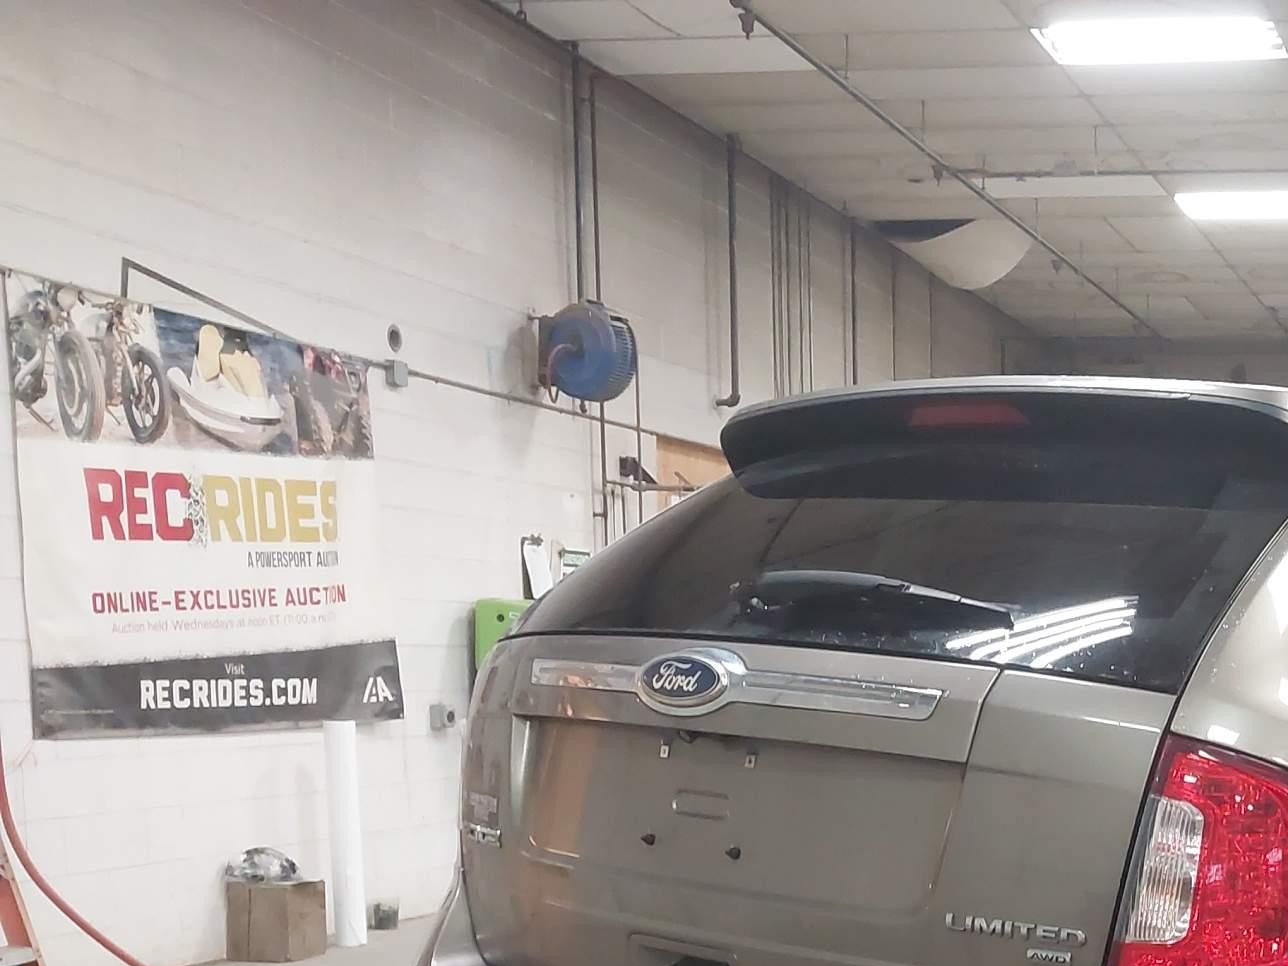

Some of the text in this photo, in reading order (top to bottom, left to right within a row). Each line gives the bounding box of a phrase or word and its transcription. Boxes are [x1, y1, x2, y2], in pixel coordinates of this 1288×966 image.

[84, 468, 338, 544] REC RIDES
[247, 551, 254, 568] A
[255, 551, 312, 568] POWERSPORT
[92, 584, 347, 614] ONLINE-EXCLUSIVE AUCTION
[224, 663, 245, 675] Visit
[652, 660, 701, 692] Ford
[140, 678, 318, 709] RECRIDES.COM
[945, 912, 1087, 946] LIMITED
[1028, 949, 1070, 966] AWD
